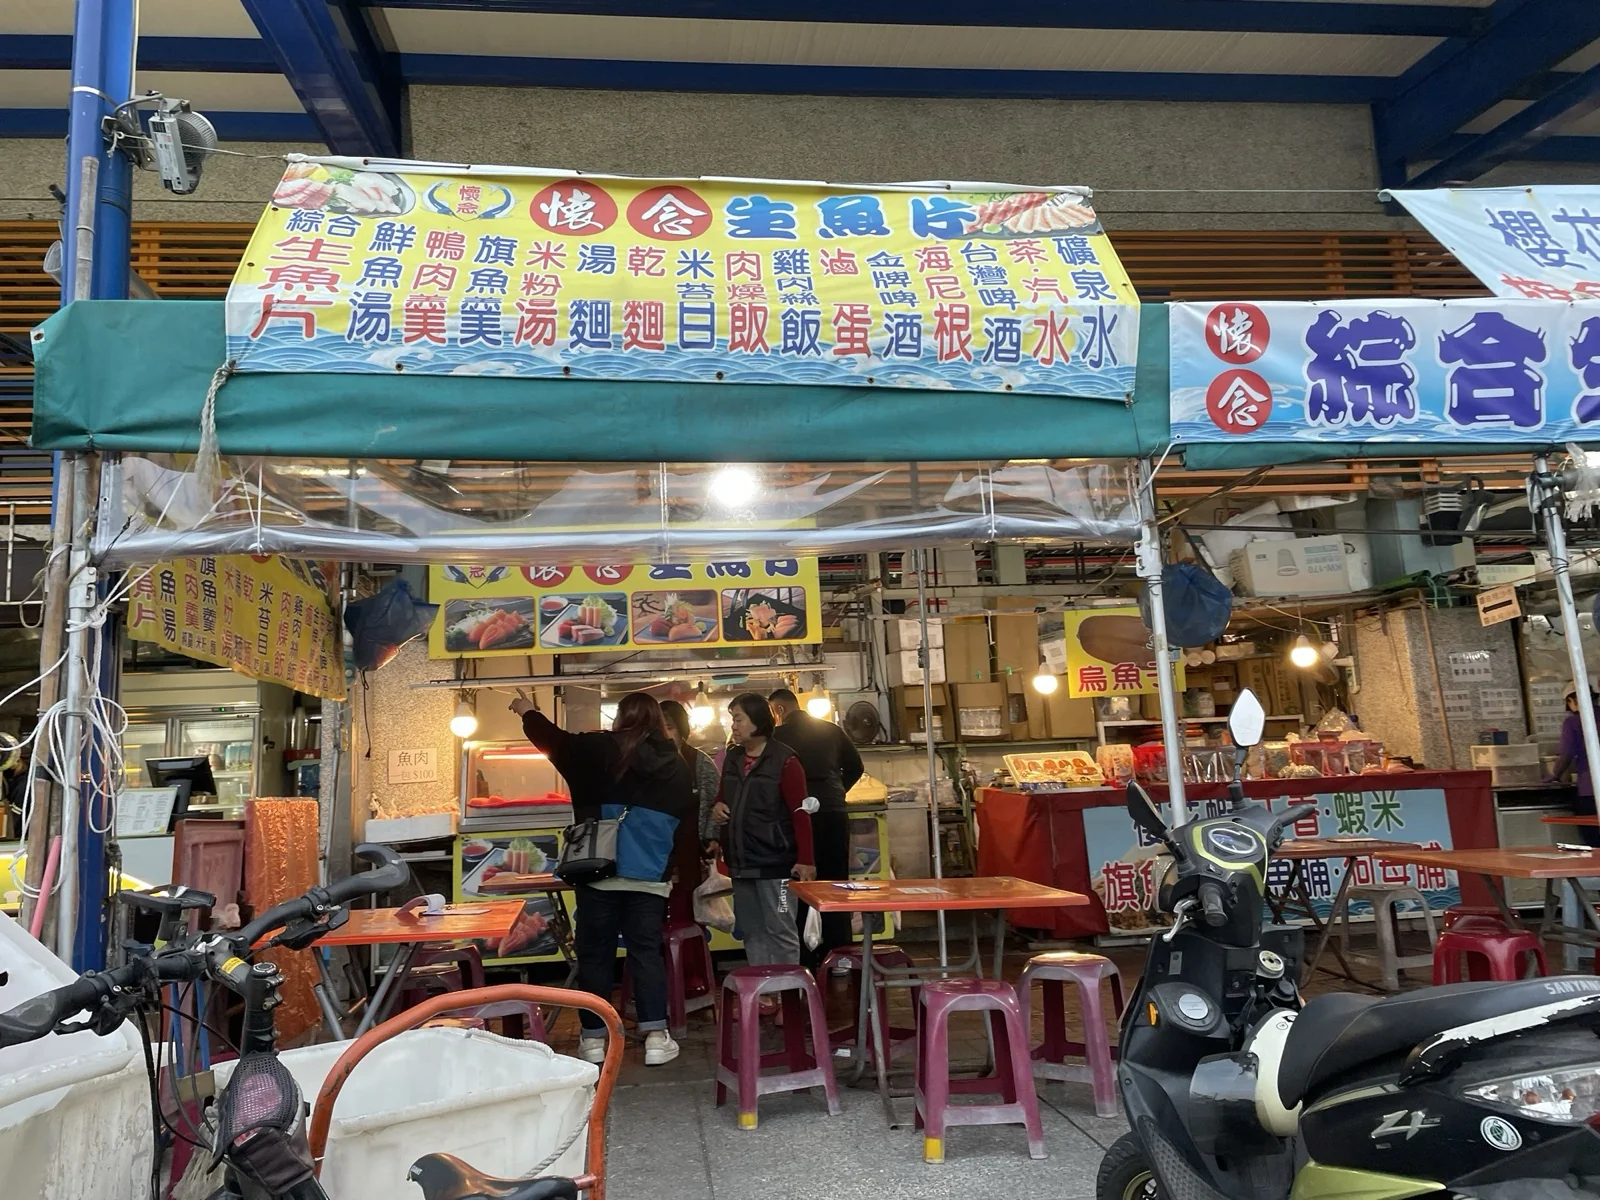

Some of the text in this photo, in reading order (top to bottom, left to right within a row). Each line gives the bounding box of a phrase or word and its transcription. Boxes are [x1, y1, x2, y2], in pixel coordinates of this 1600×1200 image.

[286, 209, 362, 238] 綜合
[456, 184, 481, 215] 懷念
[251, 236, 353, 340] 生魚片
[347, 221, 416, 342] 鮮魚湯
[403, 231, 466, 344] 鴨肉羹
[459, 235, 517, 345] 旗魚羹
[514, 241, 566, 346] 米粉湯
[569, 244, 616, 350] 湯麵
[624, 246, 666, 351] 乾麵
[676, 249, 715, 349] 米苔目
[726, 251, 769, 354] 肉燥飯
[772, 249, 823, 356] 雞肉絲飯
[820, 248, 872, 357] 滷蛋
[866, 251, 923, 358] 金牌啤酒
[914, 246, 972, 362] 海尼根
[960, 242, 1022, 363] 台灣啤酒
[1051, 236, 1117, 369] 礦泉水
[1212, 307, 1269, 426] 懷念
[397, 750, 429, 767] 魚肉
[1543, 980, 1600, 995] SANYAN
